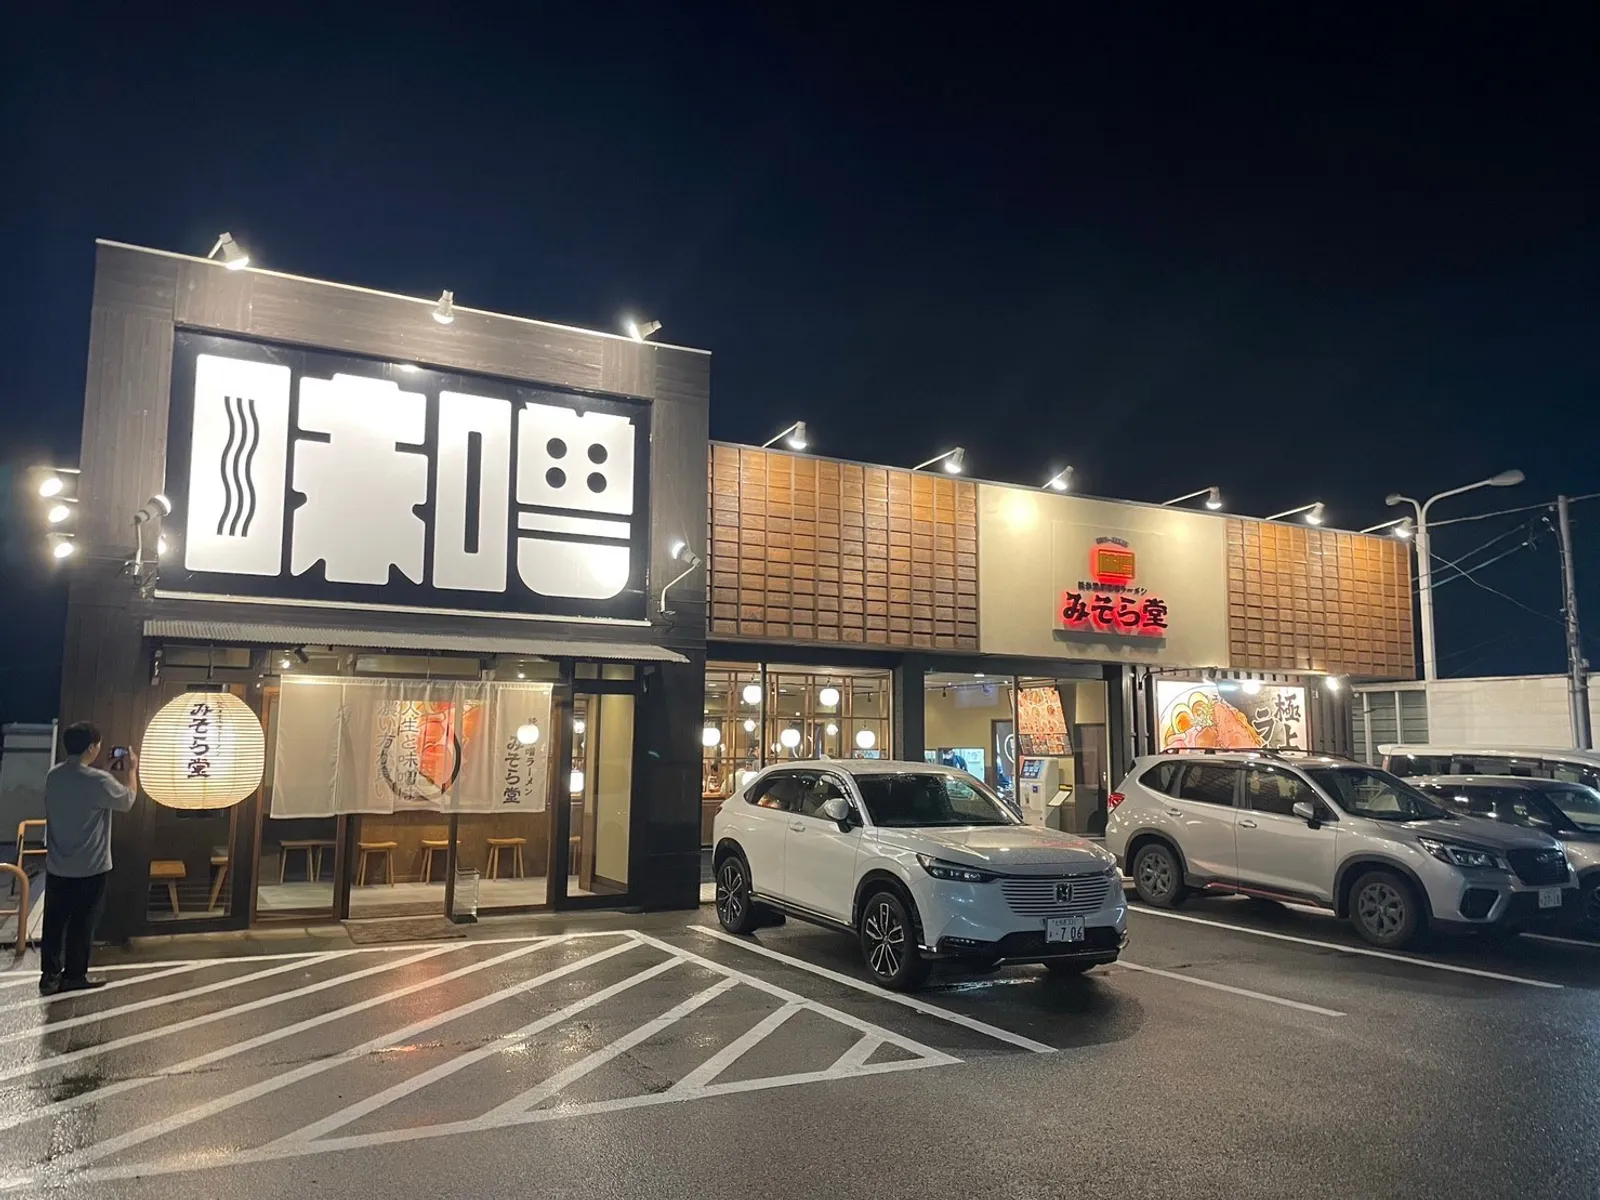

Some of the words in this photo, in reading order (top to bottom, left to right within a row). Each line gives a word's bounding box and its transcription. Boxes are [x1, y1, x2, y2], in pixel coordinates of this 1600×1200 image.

[1062, 592, 1168, 629] みそら堂
[187, 703, 214, 779] みそら堂
[502, 735, 525, 804] みそら堂
